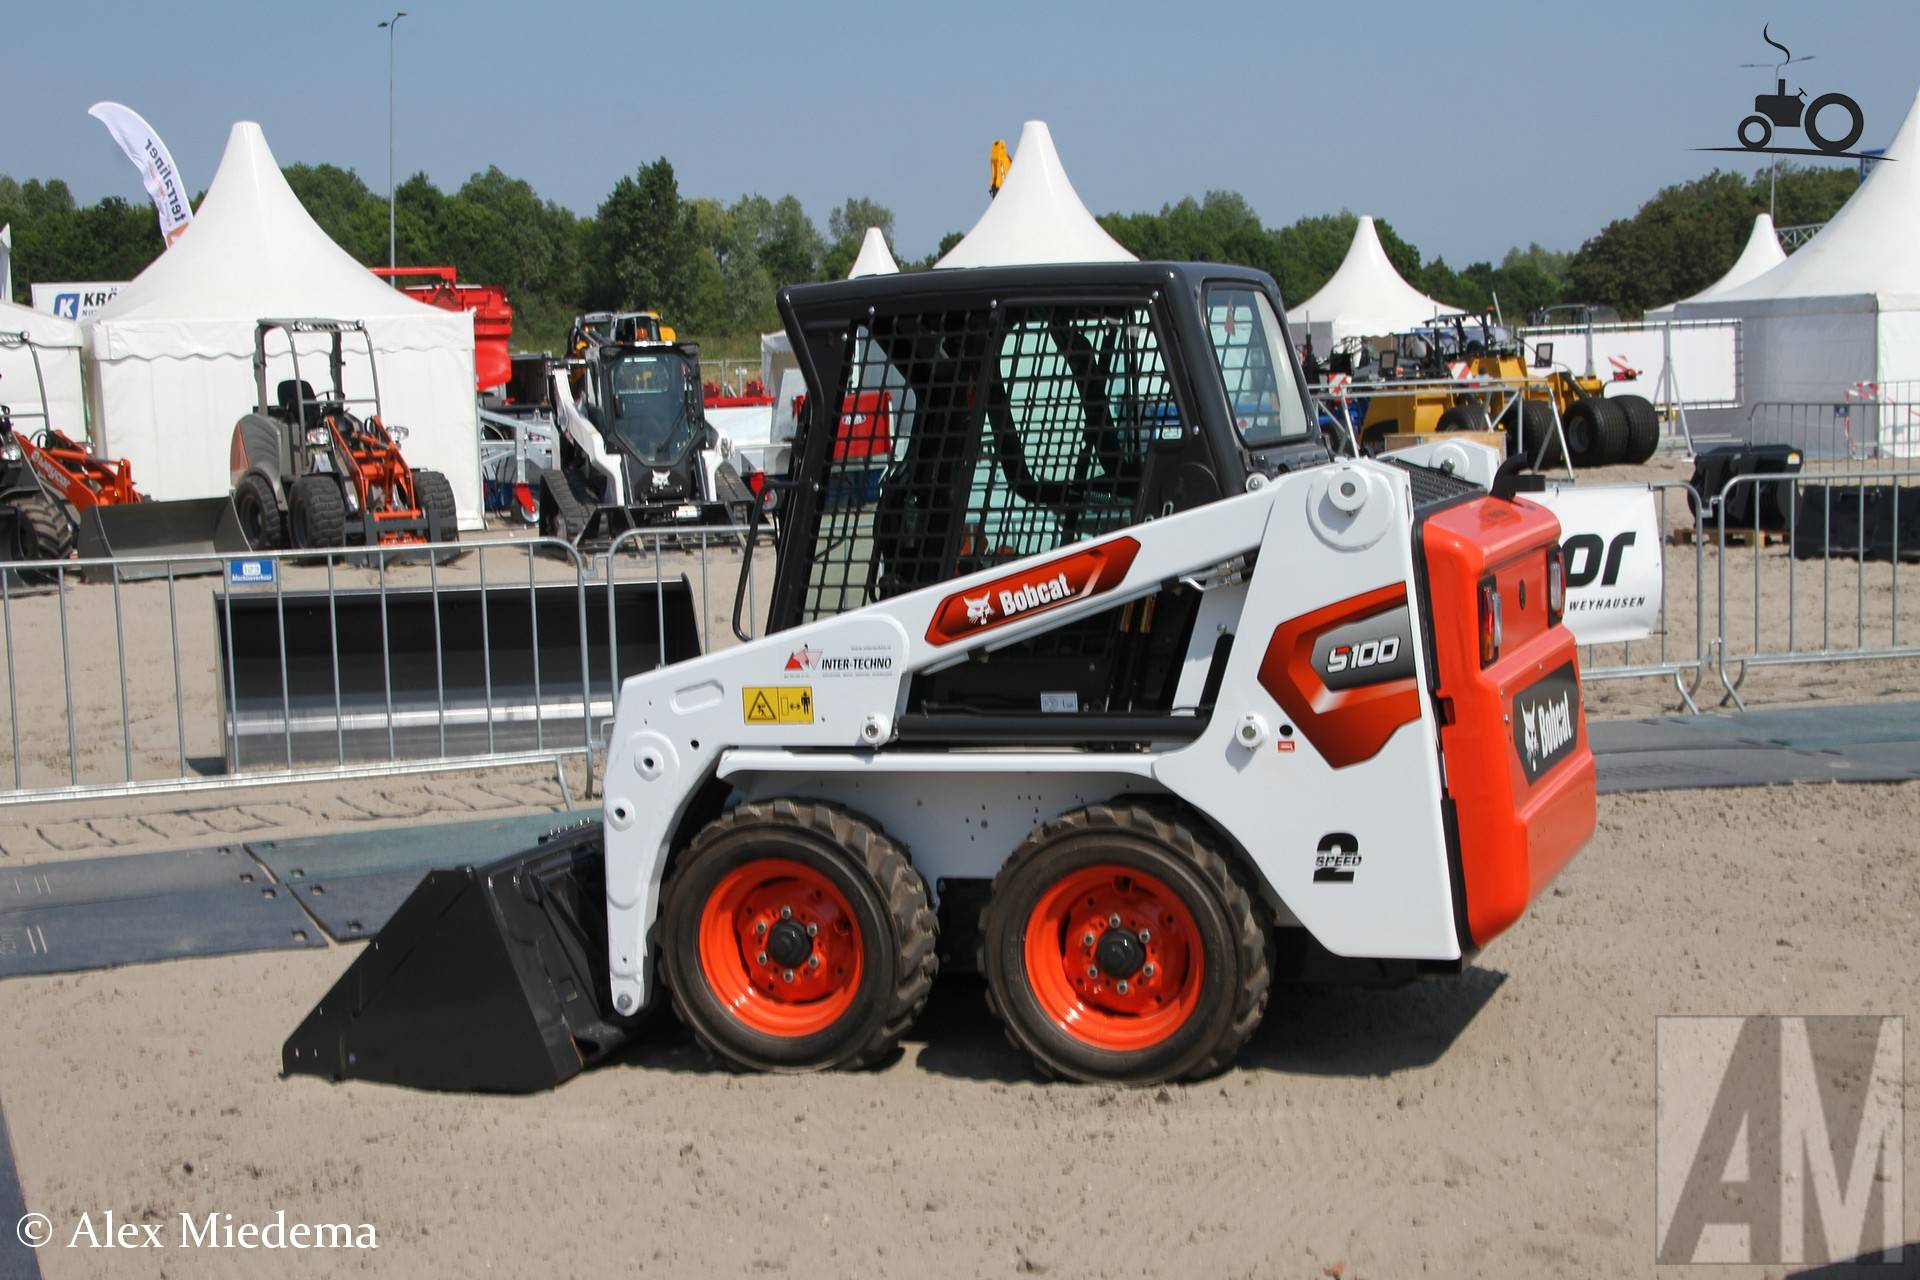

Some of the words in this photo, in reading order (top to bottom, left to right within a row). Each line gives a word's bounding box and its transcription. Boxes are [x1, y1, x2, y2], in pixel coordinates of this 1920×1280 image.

[999, 571, 1071, 616] Bobcat
[1569, 596, 1645, 612] WEYHAUSEN
[821, 657, 893, 671] INTER-TECHNO
[1327, 636, 1400, 673] S100
[1538, 690, 1572, 759] Bobcat
[1313, 832, 1359, 884] 2
[1315, 855, 1363, 867] SPEED
